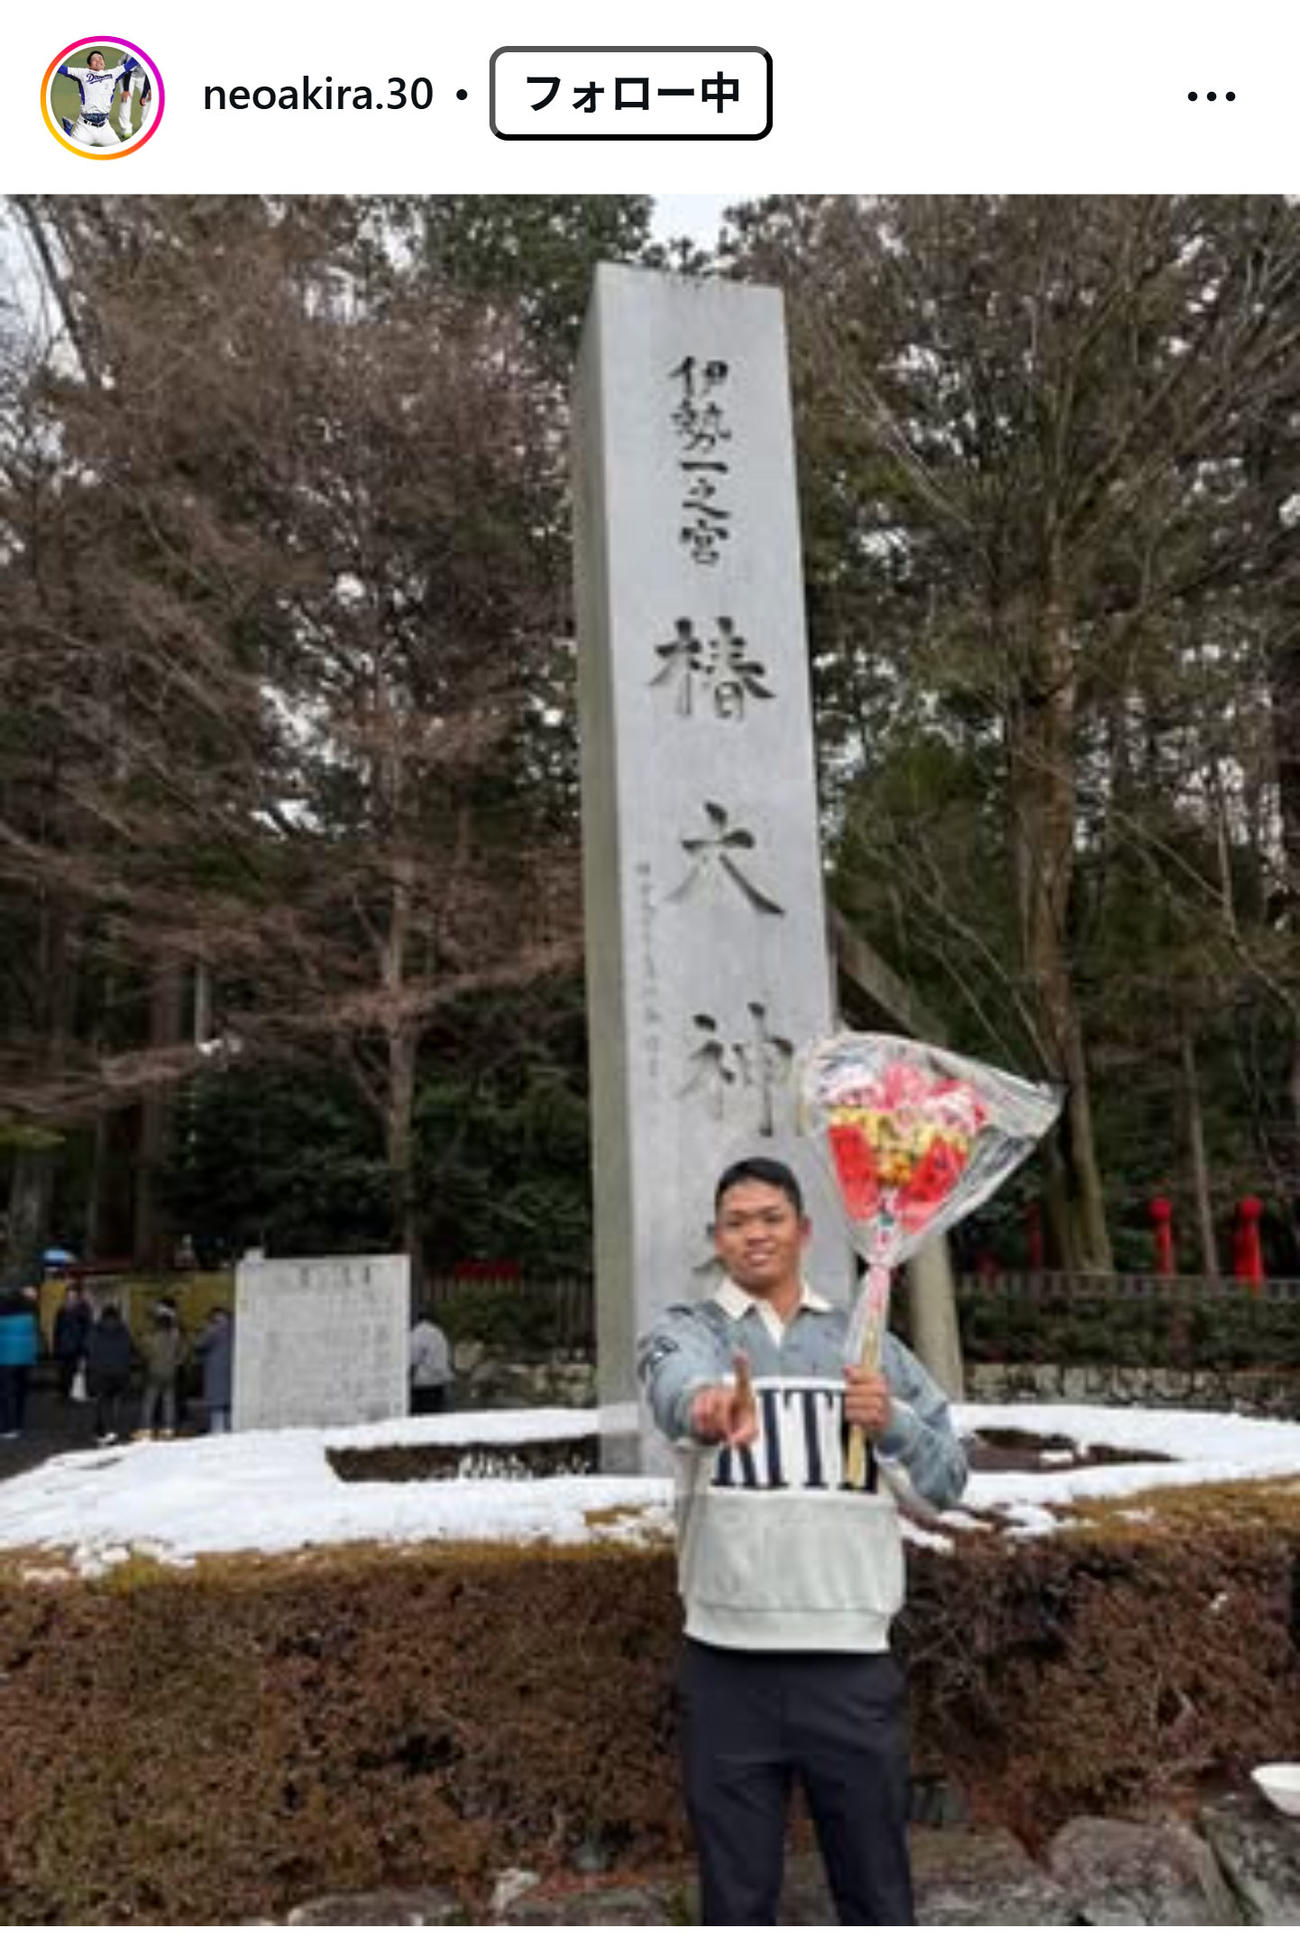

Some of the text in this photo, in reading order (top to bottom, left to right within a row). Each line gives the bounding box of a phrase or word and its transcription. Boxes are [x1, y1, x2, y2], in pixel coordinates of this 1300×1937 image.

[668, 355, 732, 566] 伊勢一之宮
[650, 616, 803, 1278] 椿大神
